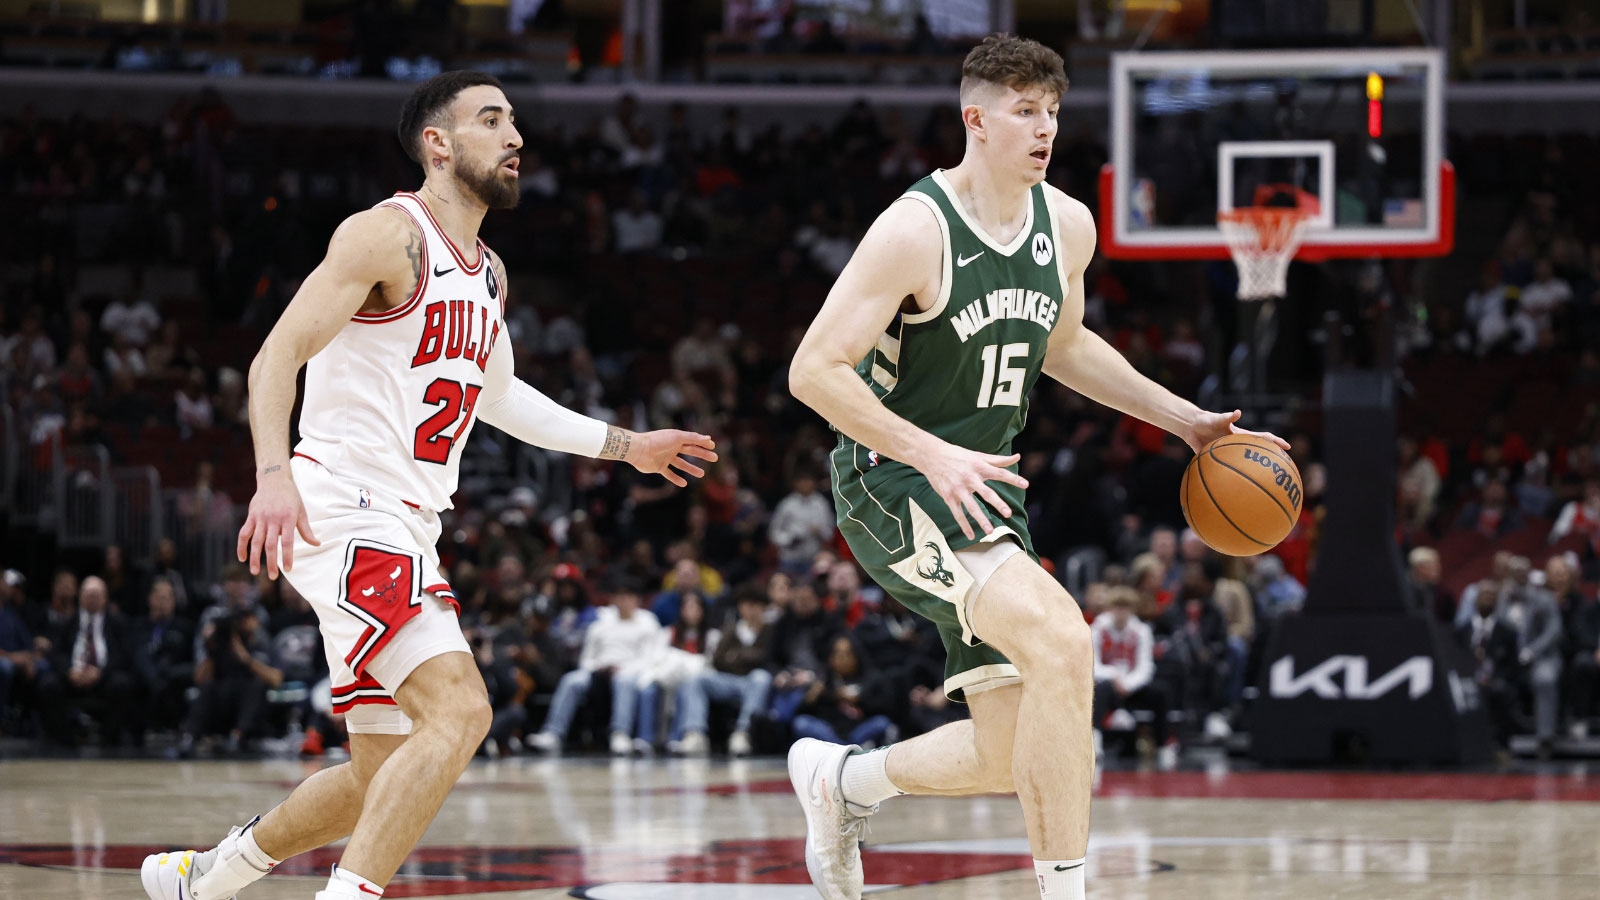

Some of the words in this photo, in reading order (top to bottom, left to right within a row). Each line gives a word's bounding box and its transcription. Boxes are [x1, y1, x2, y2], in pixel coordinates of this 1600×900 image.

[950, 288, 1059, 344] MILWAUKEE
[976, 342, 1030, 408] 15
[413, 377, 483, 465] 27
[1244, 447, 1301, 511] Wilson
[1270, 655, 1433, 699] KIA
